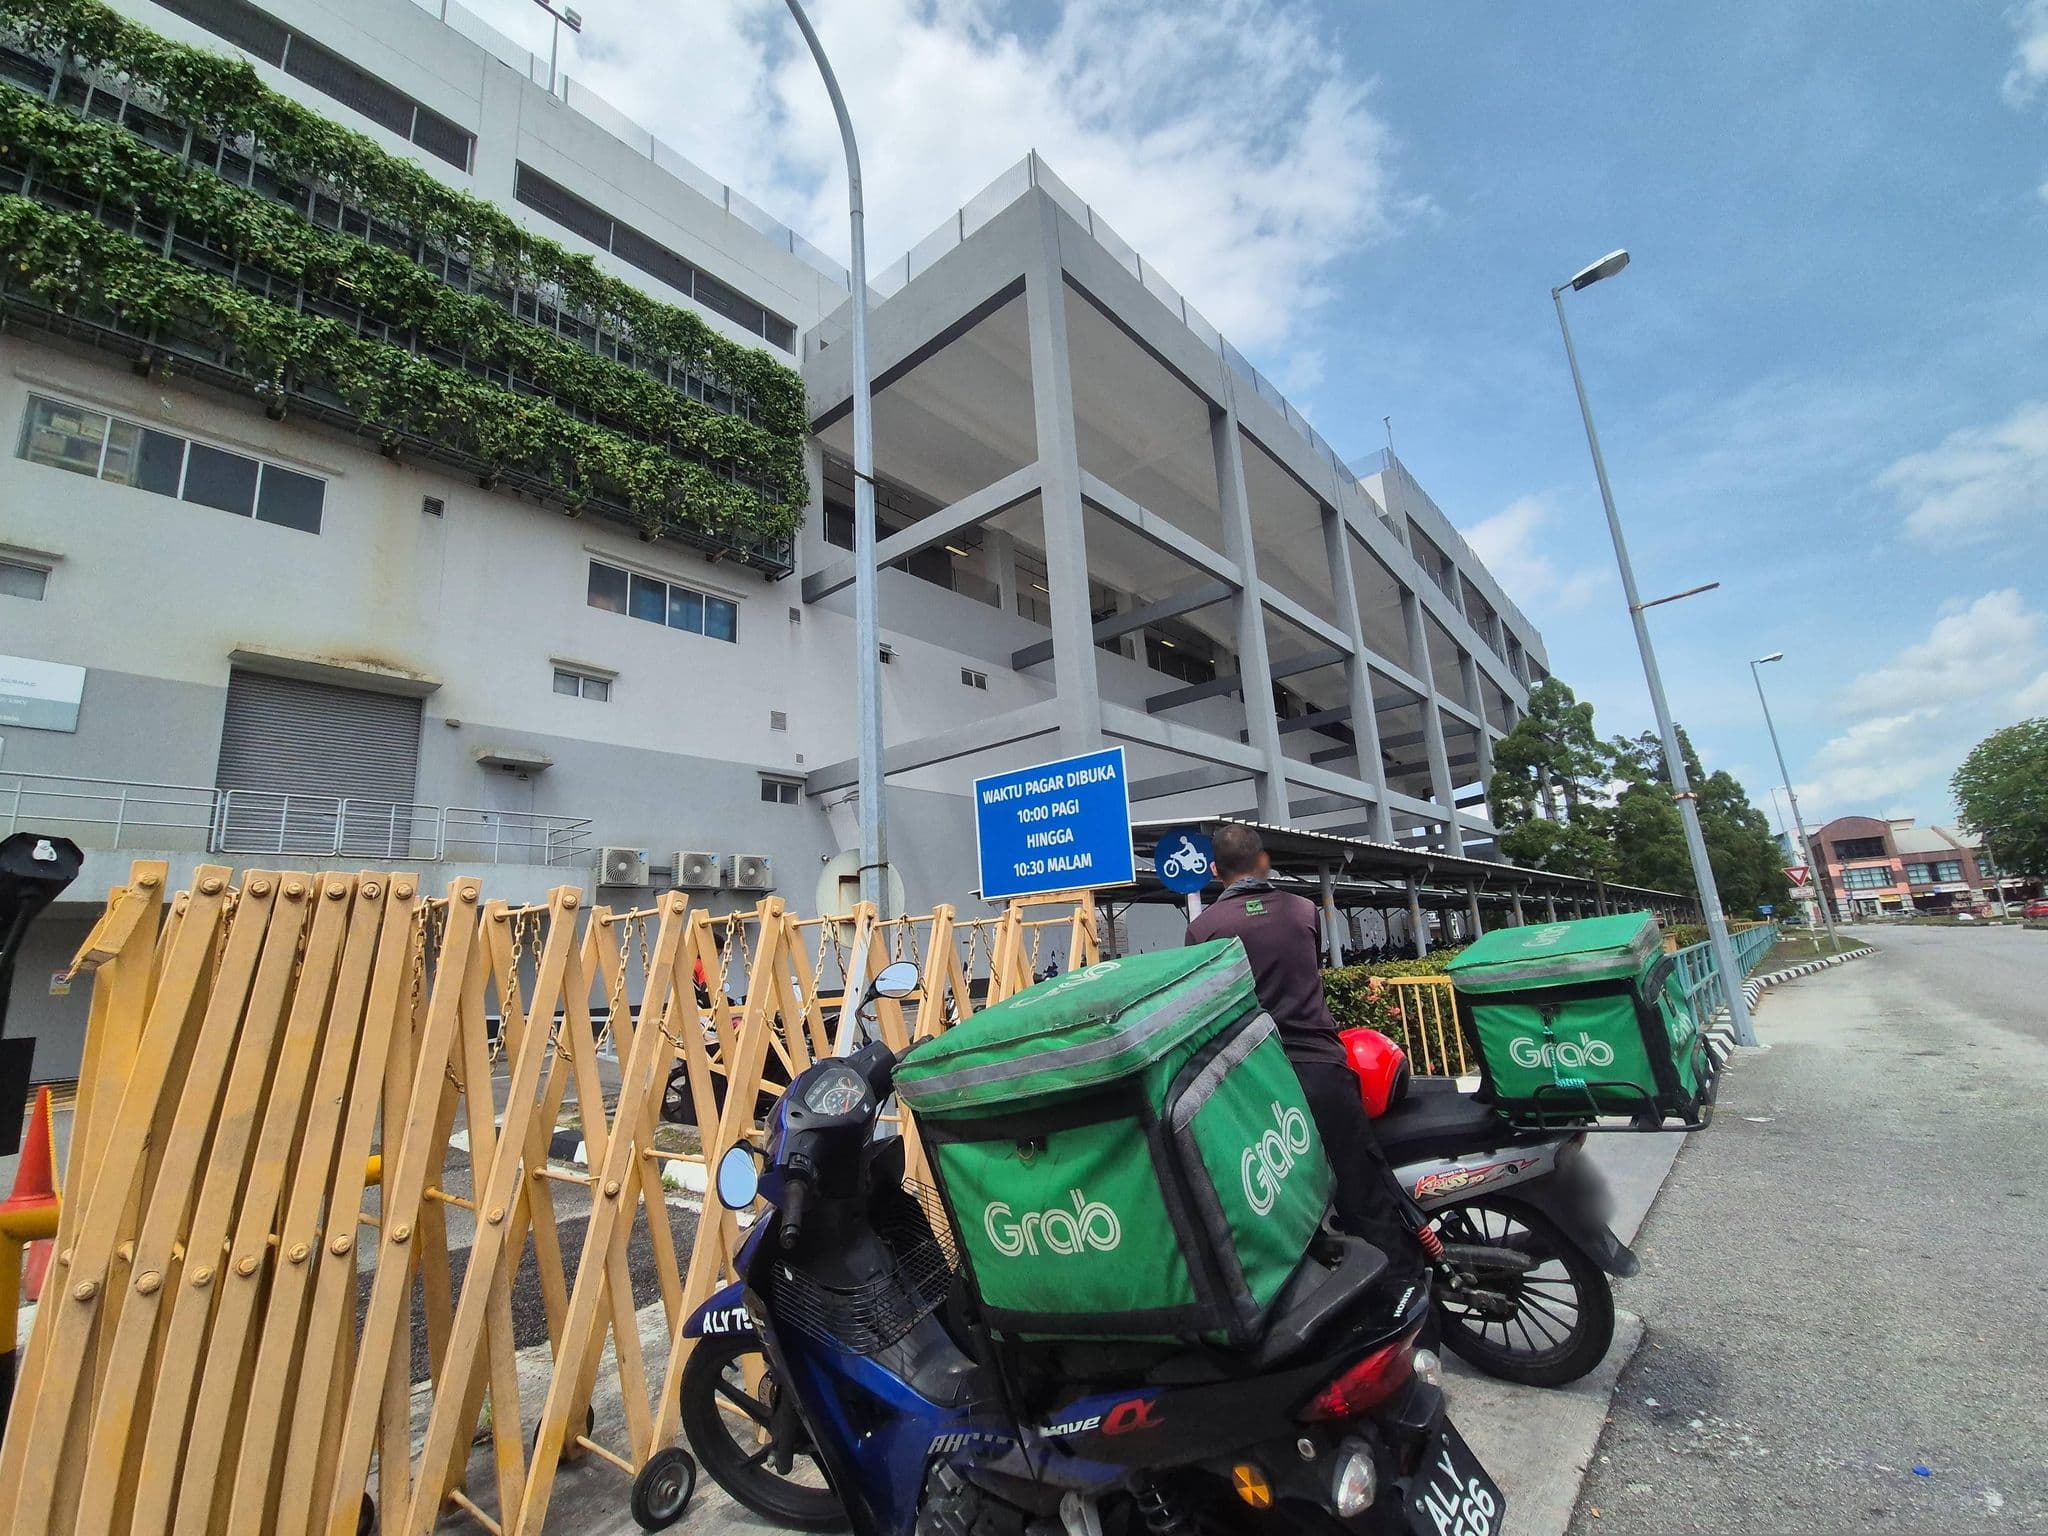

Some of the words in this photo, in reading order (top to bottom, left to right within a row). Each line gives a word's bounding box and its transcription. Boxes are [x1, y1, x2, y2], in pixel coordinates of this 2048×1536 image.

[983, 783, 1022, 805] WAKTU
[1025, 775, 1064, 796] PAGAR
[1067, 764, 1116, 788] DIBUKA
[1017, 806, 1049, 823] 10:00
[1052, 799, 1080, 817] PAGI
[1027, 828, 1074, 848] HINGGA
[1014, 860, 1044, 877] 10:30
[1047, 853, 1093, 872] MALAM
[1510, 1032, 1615, 1069] Grab
[1240, 1101, 1311, 1216] Grab
[984, 1189, 1121, 1257] Grab
[703, 1311, 730, 1334] ALY
[1424, 1451, 1464, 1536] ALY
